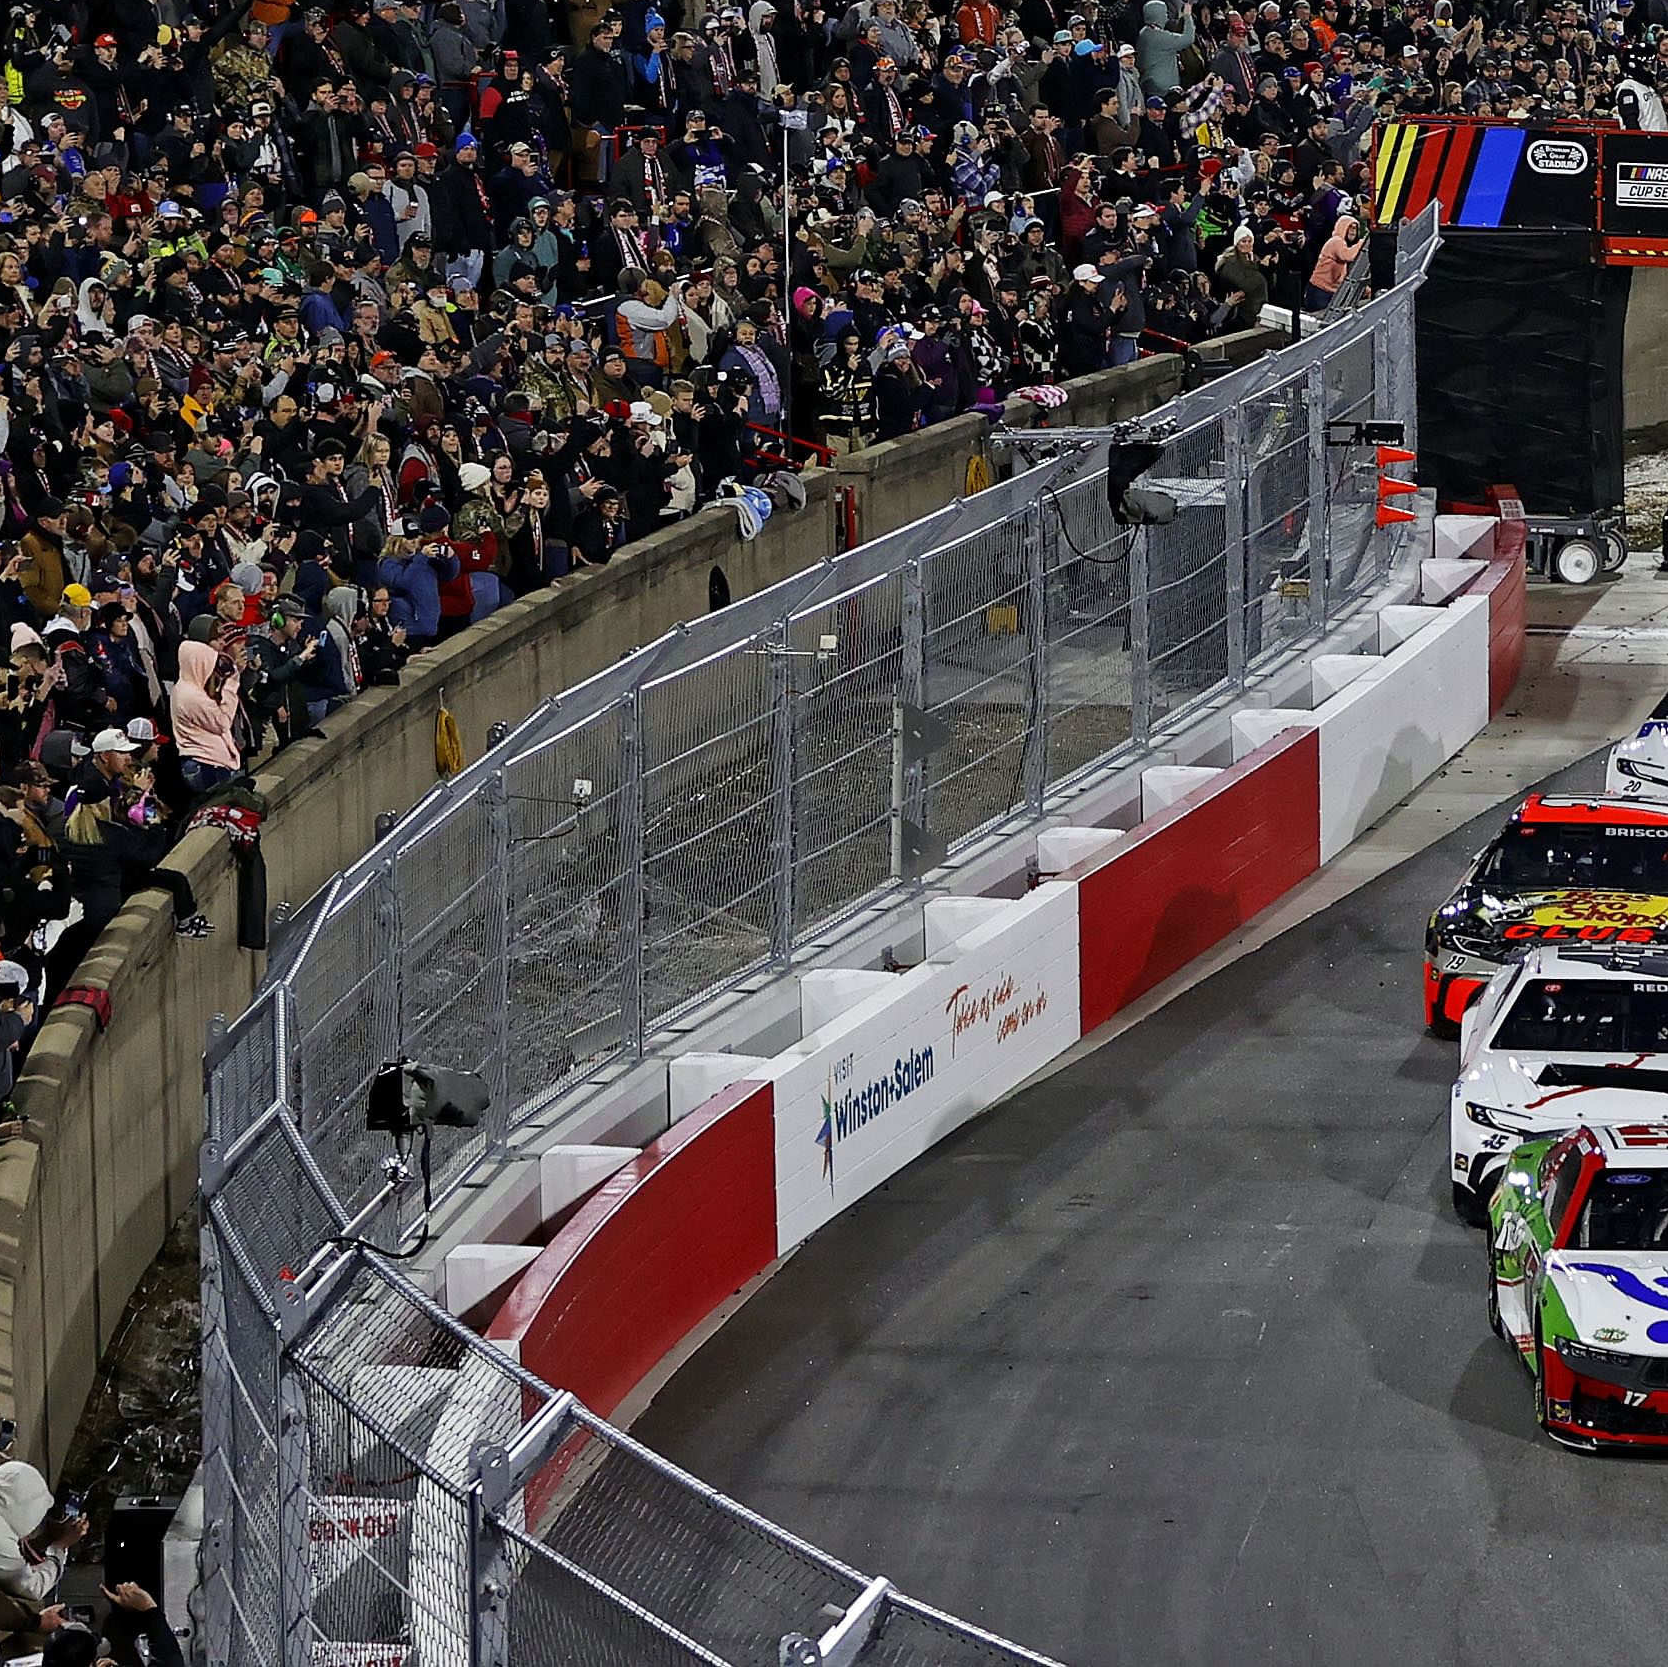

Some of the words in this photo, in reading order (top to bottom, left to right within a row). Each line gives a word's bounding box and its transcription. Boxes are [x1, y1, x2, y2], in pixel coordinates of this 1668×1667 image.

[1538, 160, 1578, 169] STADIUM
[1629, 185, 1654, 198] CUP
[1623, 779, 1642, 793] 20
[1555, 908, 1668, 927] Shops
[1502, 924, 1657, 943] CLUB
[1443, 954, 1468, 971] 19
[1623, 1390, 1648, 1407] 17
